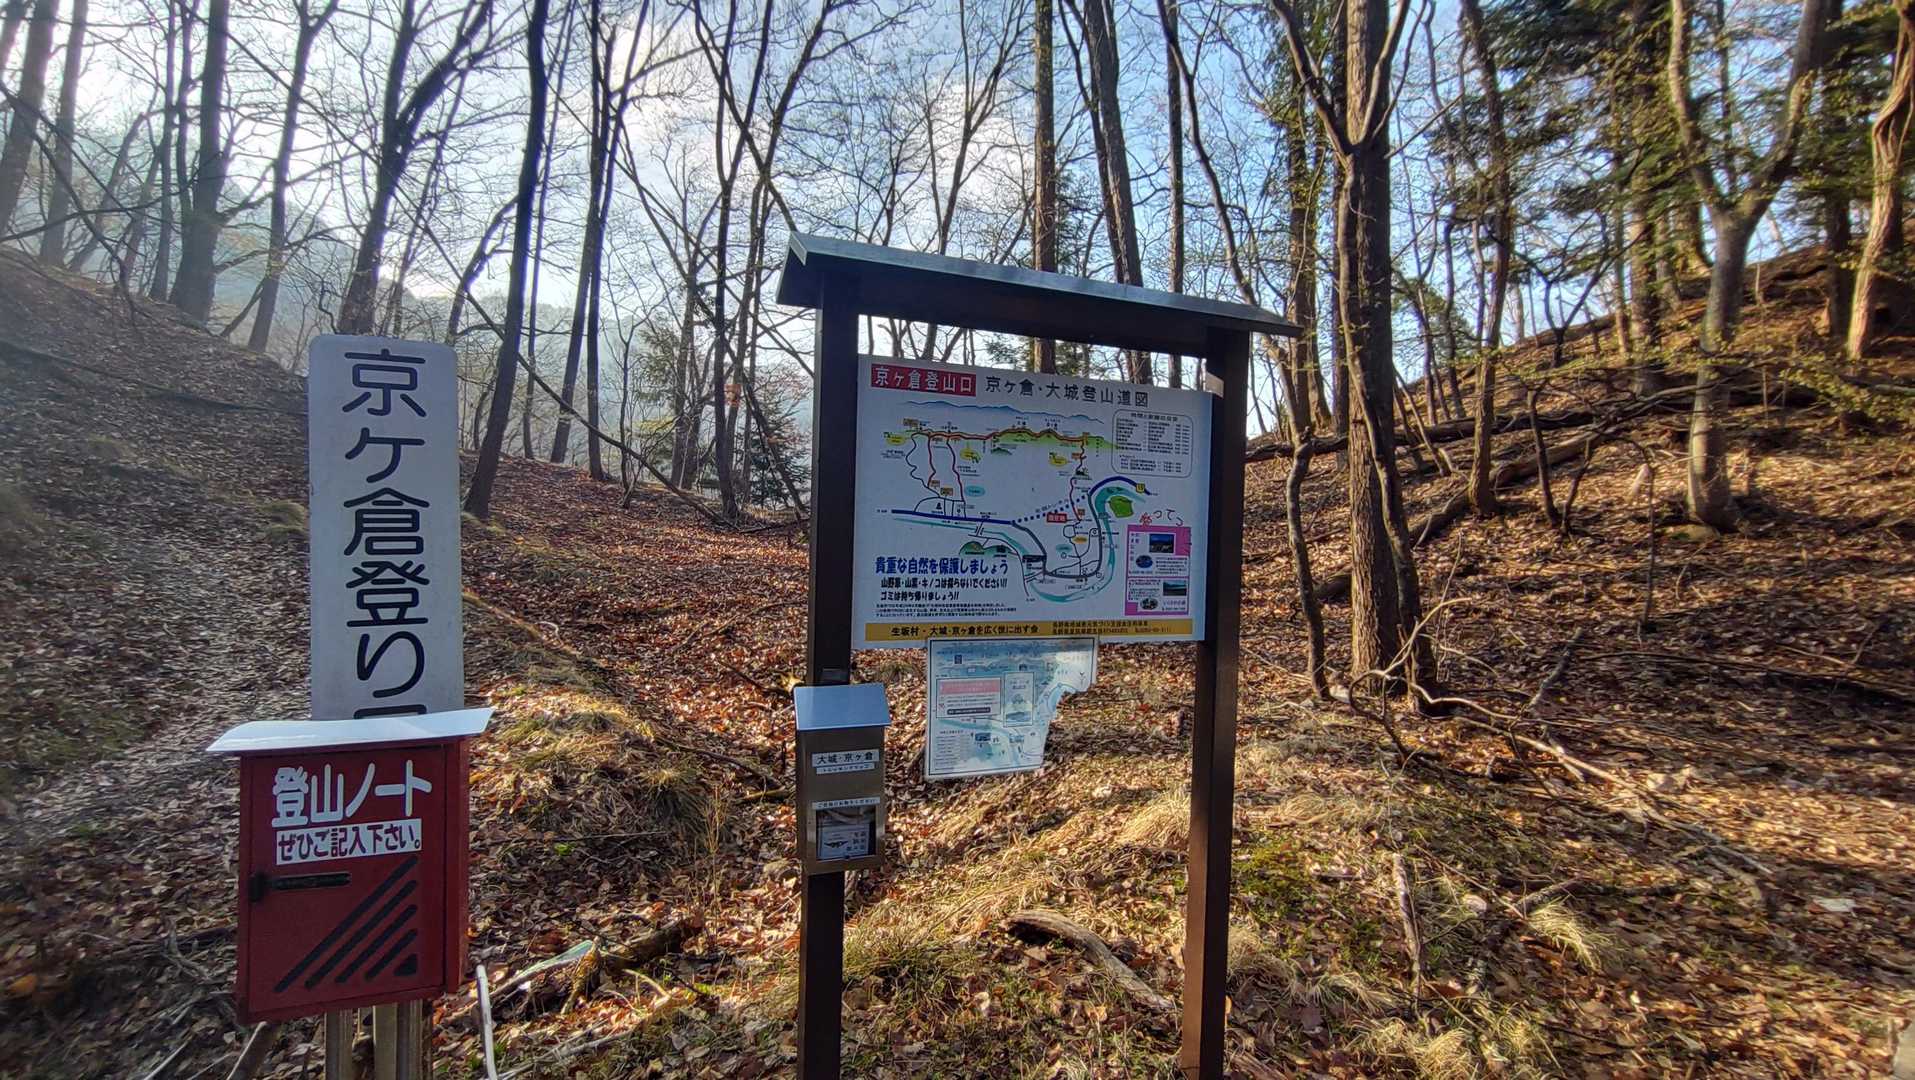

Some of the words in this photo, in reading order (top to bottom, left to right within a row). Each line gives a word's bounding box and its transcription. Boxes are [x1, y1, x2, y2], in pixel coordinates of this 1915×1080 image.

[342, 349, 431, 720] 京ケ倉登り
[875, 556, 1009, 574] 貴重な自然を保護しましょう
[272, 759, 432, 828] 登山ノート
[279, 823, 421, 861] ぜひご記入下さい。
